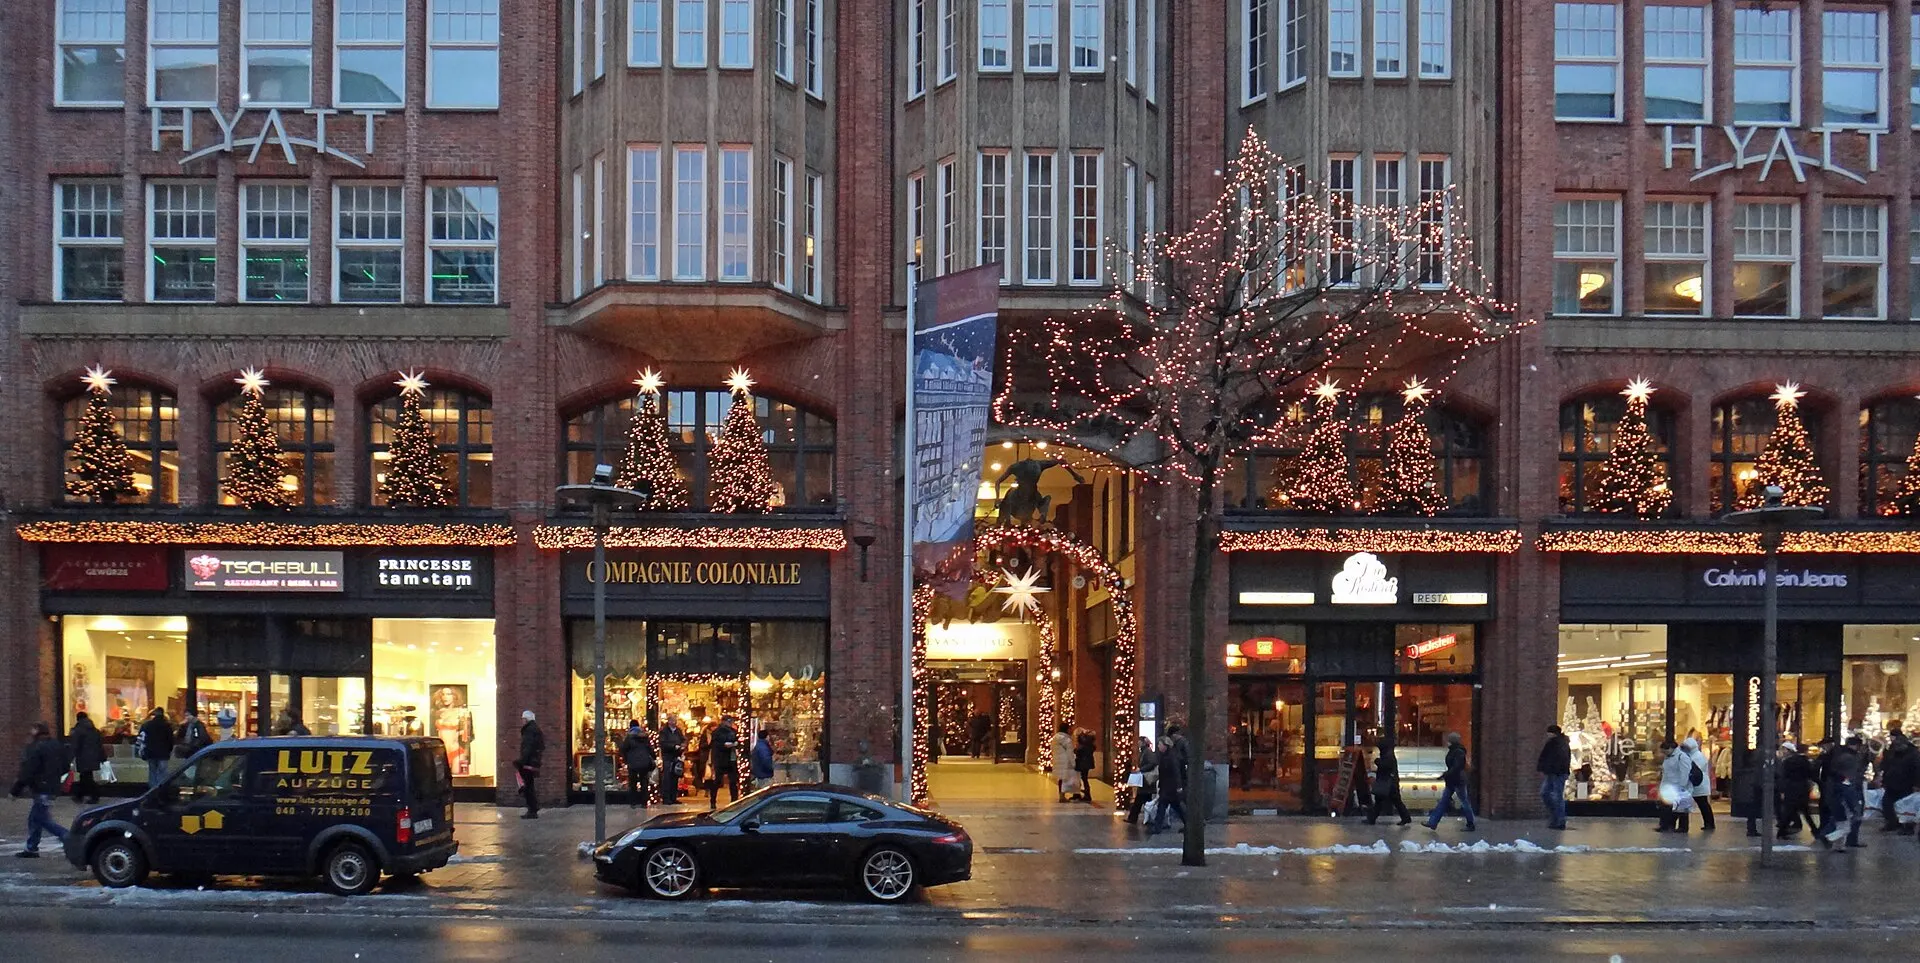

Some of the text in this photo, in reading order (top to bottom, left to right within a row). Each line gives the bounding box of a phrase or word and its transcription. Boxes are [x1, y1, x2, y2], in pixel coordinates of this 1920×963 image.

[152, 107, 387, 168] HYATT
[1664, 125, 1890, 184] HYATT
[85, 567, 129, 576] GEWÜRZE
[220, 560, 338, 575] TSCHEBULL
[379, 559, 472, 571] PRINCESSE
[585, 561, 801, 584] COMPAGNIE COLONIALE
[223, 579, 279, 587] RESTAURANT
[1703, 568, 1848, 587] Calvin Kein Jeans
[1748, 676, 1761, 704] Calvin
[1748, 704, 1761, 725] Klein
[277, 749, 373, 775] LUTZ
[276, 776, 372, 789] AUFZÜGE
[275, 806, 296, 816] 040
